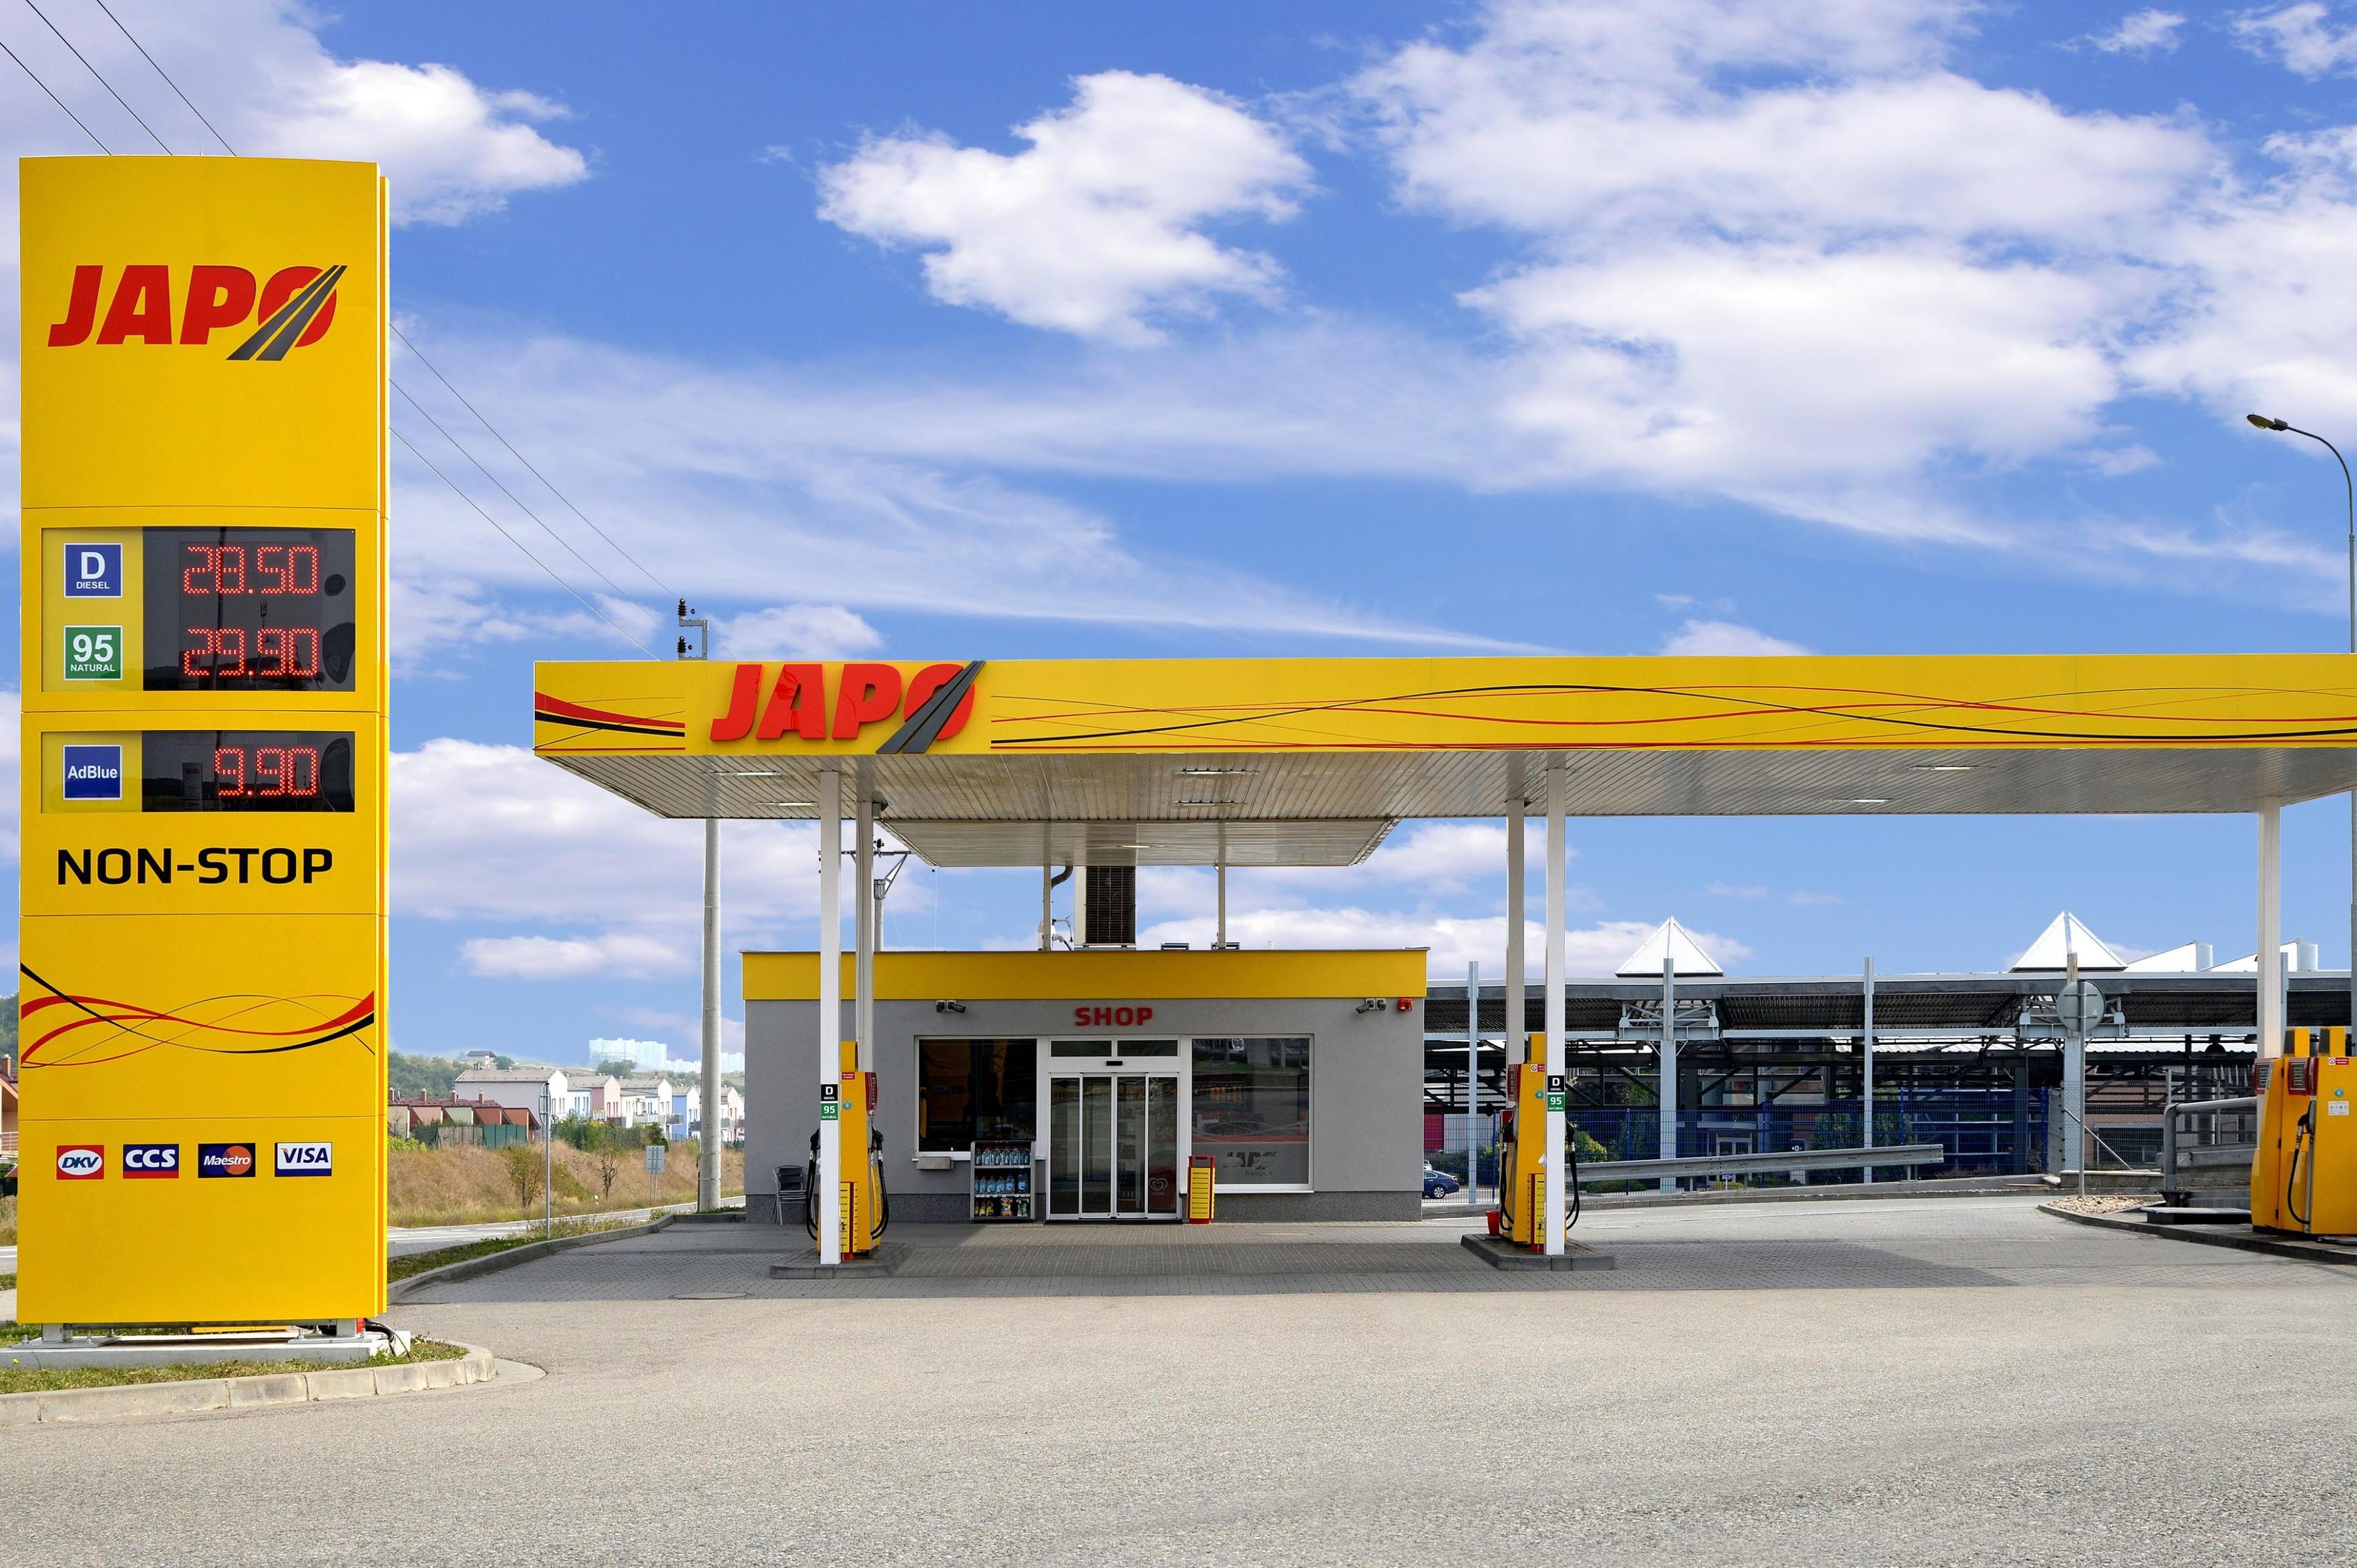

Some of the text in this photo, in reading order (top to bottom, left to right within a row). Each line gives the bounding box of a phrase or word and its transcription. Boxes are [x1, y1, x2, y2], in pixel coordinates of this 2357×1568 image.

[47, 264, 339, 349] JAPO
[81, 552, 106, 580] D
[184, 546, 319, 594] 28.50
[76, 581, 110, 589] DIESEL
[73, 634, 114, 662] 95
[184, 628, 319, 676] 29.90
[70, 664, 116, 672] NATURAL
[709, 663, 976, 742] JAPO
[67, 765, 118, 779] AdBlue
[214, 747, 317, 796] 9.90
[57, 848, 333, 885] NON-STOP
[1075, 1006, 1153, 1026] SHOP
[825, 1086, 834, 1095] D
[1552, 1077, 1560, 1087] D
[824, 1105, 836, 1114] 95
[1550, 1097, 1562, 1105] 95
[61, 1157, 100, 1169] DKV
[125, 1149, 176, 1168] CCS
[204, 1155, 250, 1166] Maestro
[279, 1147, 329, 1164] VISA
